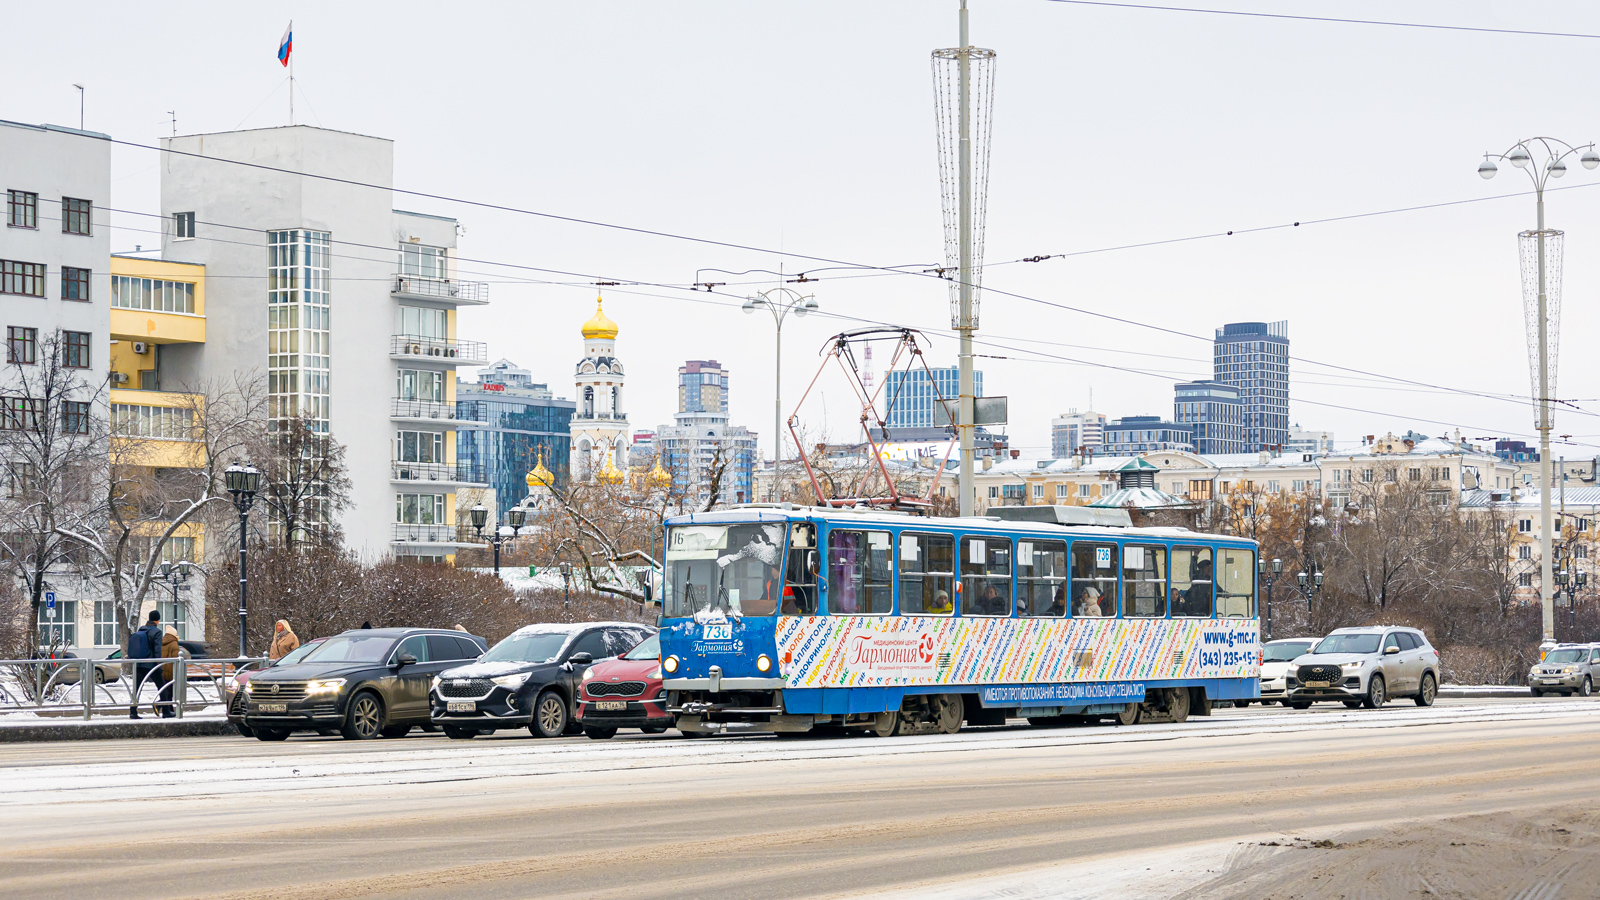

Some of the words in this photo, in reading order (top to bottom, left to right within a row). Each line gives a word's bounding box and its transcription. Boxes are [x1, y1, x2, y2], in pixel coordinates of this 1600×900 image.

[674, 533, 684, 545] 16
[1097, 549, 1109, 560] 736
[691, 641, 732, 653] Гармония
[706, 626, 729, 638] 736
[951, 619, 964, 646] ХИРУРГ
[1020, 652, 1035, 681] МАССАЖ
[1035, 619, 1047, 645] ХИРУРГ
[1204, 629, 1257, 647] www.g-mc.r
[791, 624, 832, 687] ЭНДОКРИНОЛОГ
[804, 644, 832, 687] НЕВРОЛОГ
[818, 616, 856, 687] ГАСТРОЭНТЕРОЛО
[849, 635, 917, 669] Гармония
[943, 627, 970, 684] ФИЗИОТЕРАПИЯ
[951, 641, 970, 683] ГИНЕКОЛОГ
[971, 621, 979, 638] ЛОР
[959, 648, 975, 682] ТЕРАПЕВТ
[967, 649, 982, 684] ПЕДИАТР
[974, 629, 998, 684] ОФТАЛЬМОЛОГ
[990, 625, 1015, 682] ЭНДОКРИНОЛОГ
[998, 644, 1014, 683] НЕВРОЛОГ
[1013, 638, 1031, 681] КАРДИОЛОГ
[1028, 627, 1052, 684] ФИЗИОТЕРАПИЯ
[1035, 641, 1052, 682] ГИНЕКОЛОГ
[1042, 647, 1057, 681] ТЕРАПЕВТ
[1049, 649, 1063, 681] ПЕДИАТР
[1056, 630, 1078, 682] ОФТАЛЬМОЛОГ
[1092, 638, 1109, 679] КАРДИОЛОГ
[1099, 650, 1112, 679] МАССАЖ
[1112, 641, 1128, 680] ГИНЕКОЛОГ
[1118, 647, 1132, 679] ТЕРАПЕВТ
[1125, 648, 1138, 679] ПЕДИАТР
[1199, 648, 1222, 669] (343)
[1224, 651, 1258, 665] 235-15-
